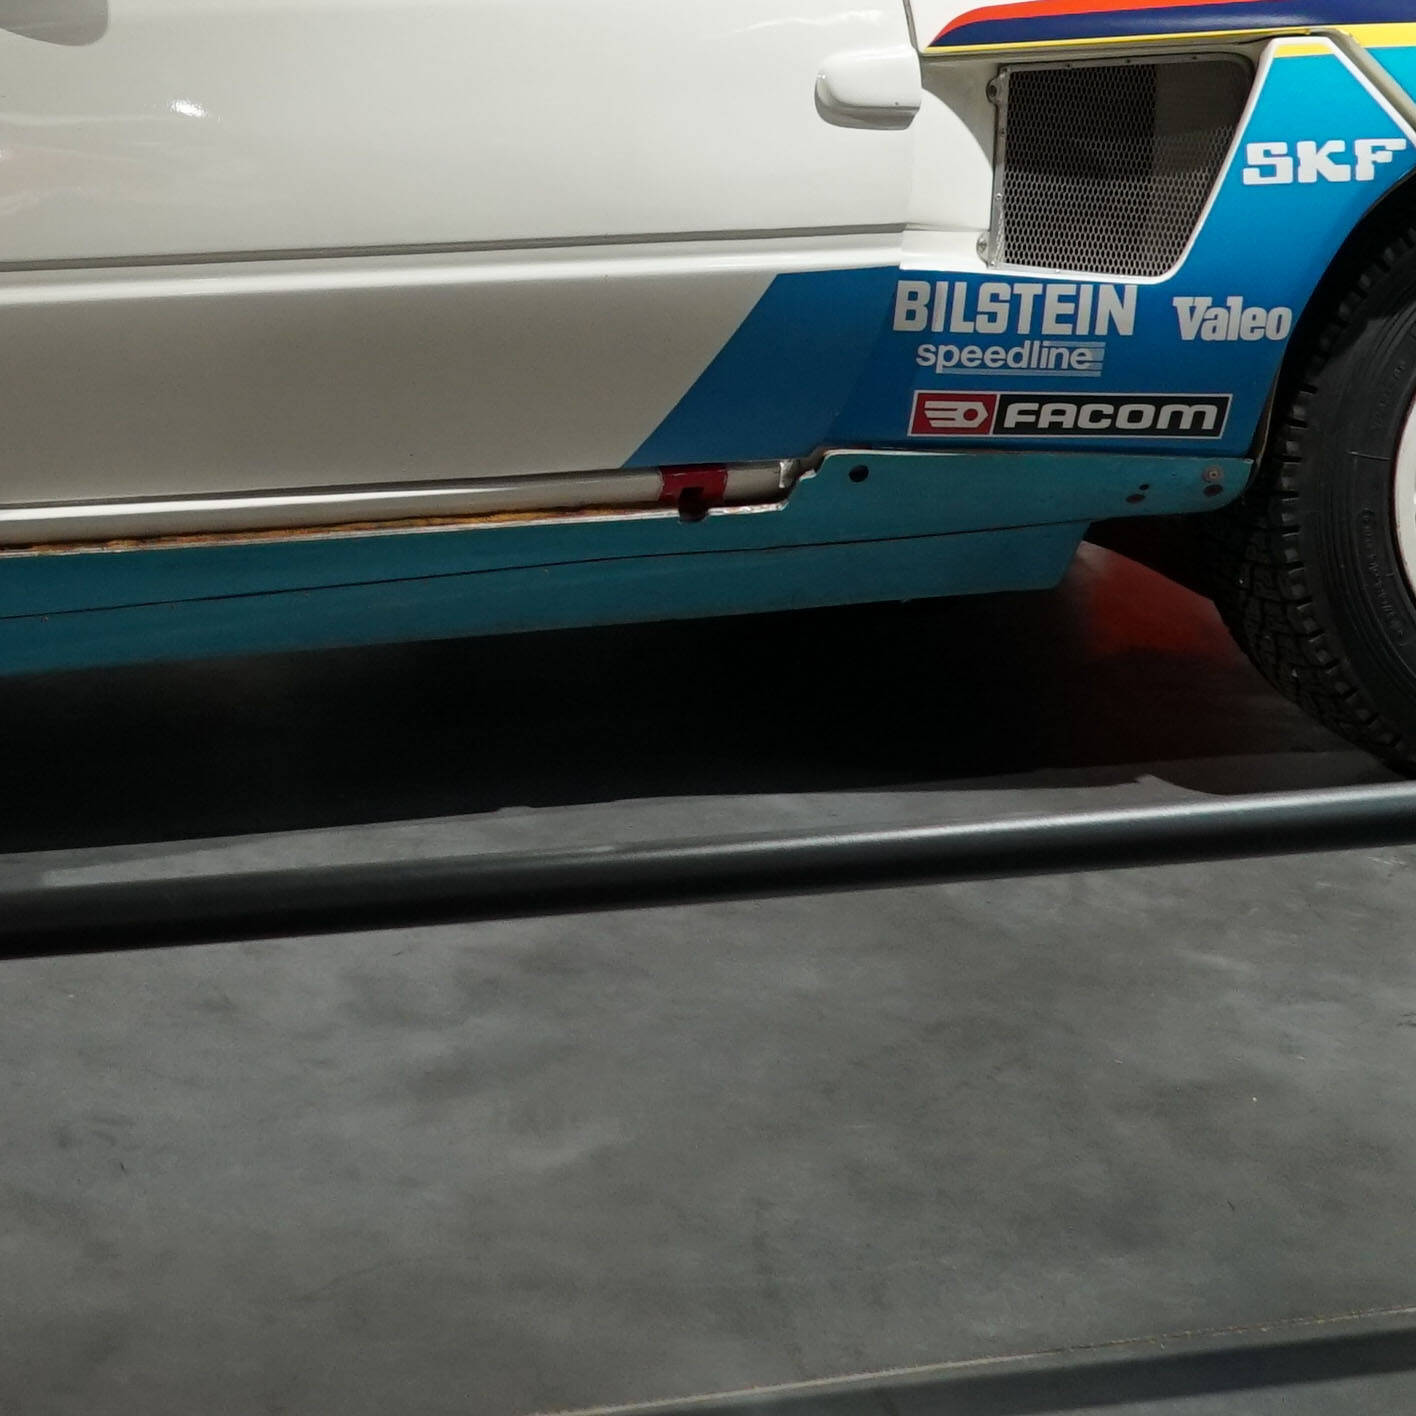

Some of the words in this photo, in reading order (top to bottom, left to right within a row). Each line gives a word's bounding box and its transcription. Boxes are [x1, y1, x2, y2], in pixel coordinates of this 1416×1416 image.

[1242, 137, 1408, 186] SKF
[892, 279, 1139, 337] BILSTEIN
[1172, 295, 1293, 342] Valeo
[915, 340, 1098, 374] speedline
[1003, 401, 1220, 431] FACOM
